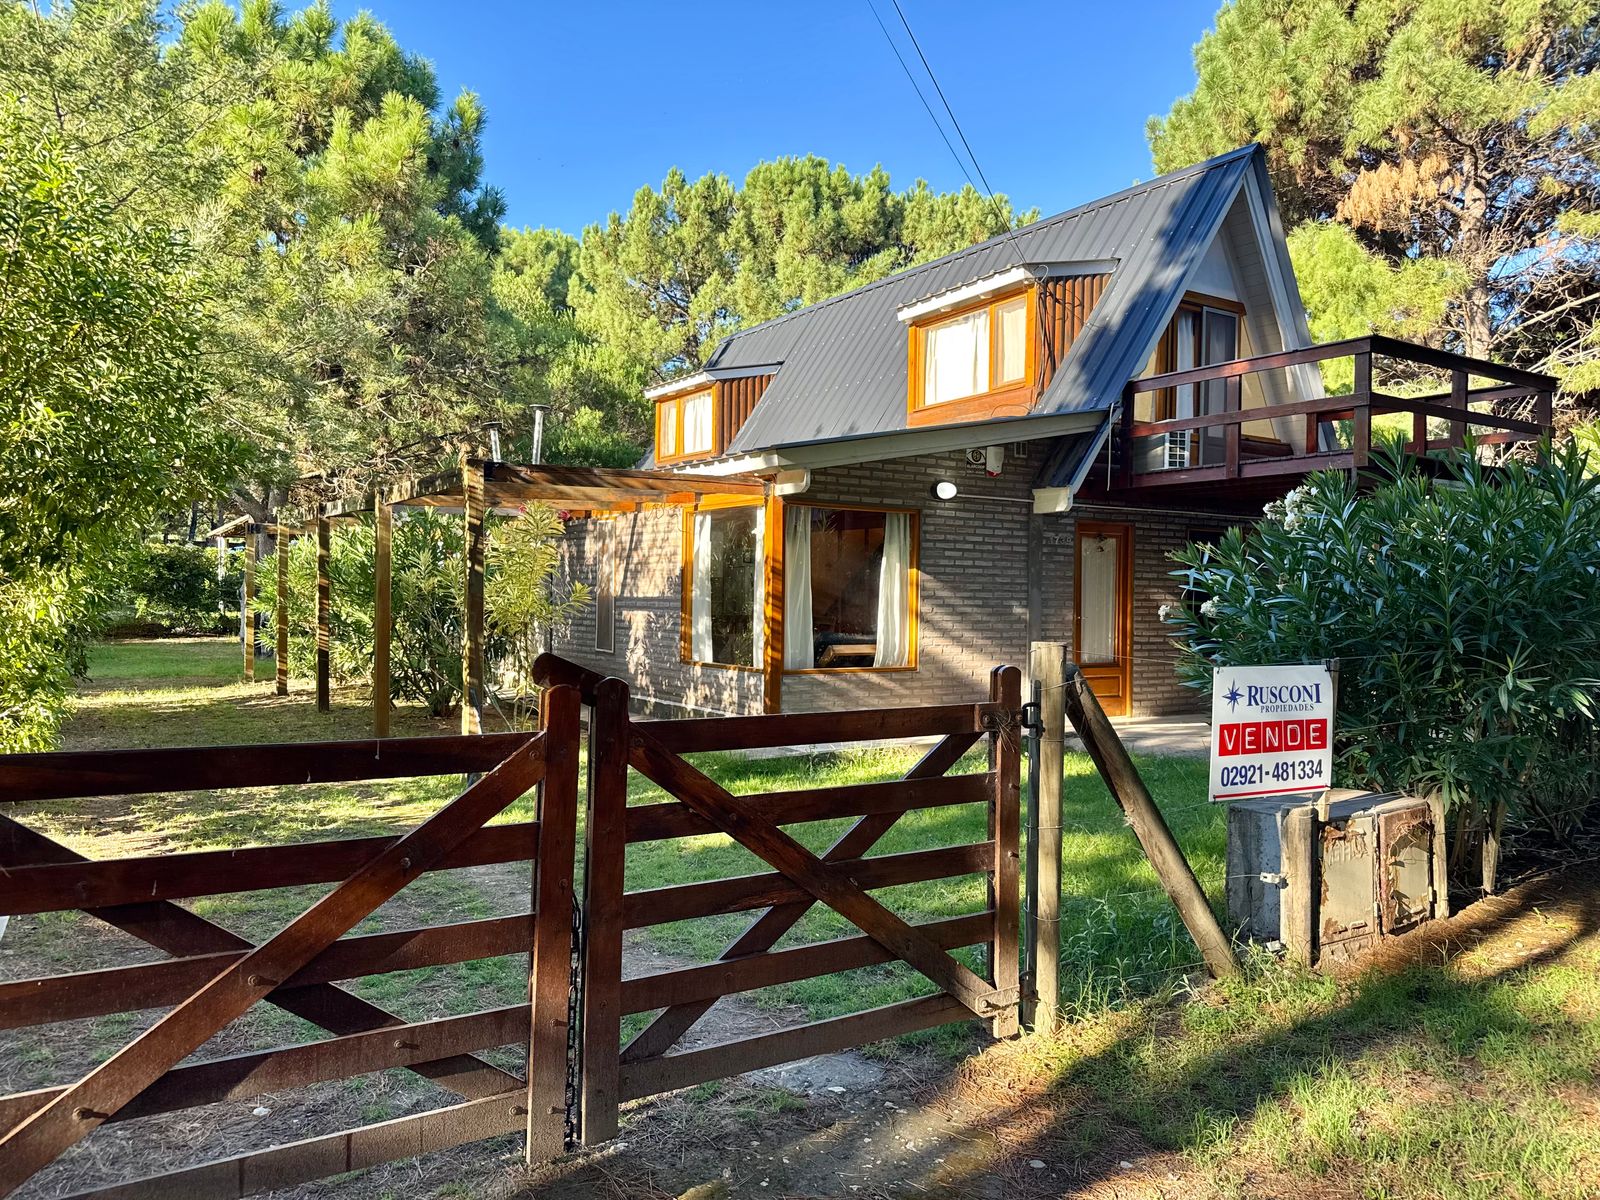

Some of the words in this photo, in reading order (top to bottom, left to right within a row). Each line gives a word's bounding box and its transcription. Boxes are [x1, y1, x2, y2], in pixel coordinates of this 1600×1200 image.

[1247, 683, 1322, 706] RUSCONI
[1260, 703, 1315, 713] PROPIEDADES
[1223, 723, 1322, 751] VENDE
[1220, 759, 1323, 787] 02921-481334
